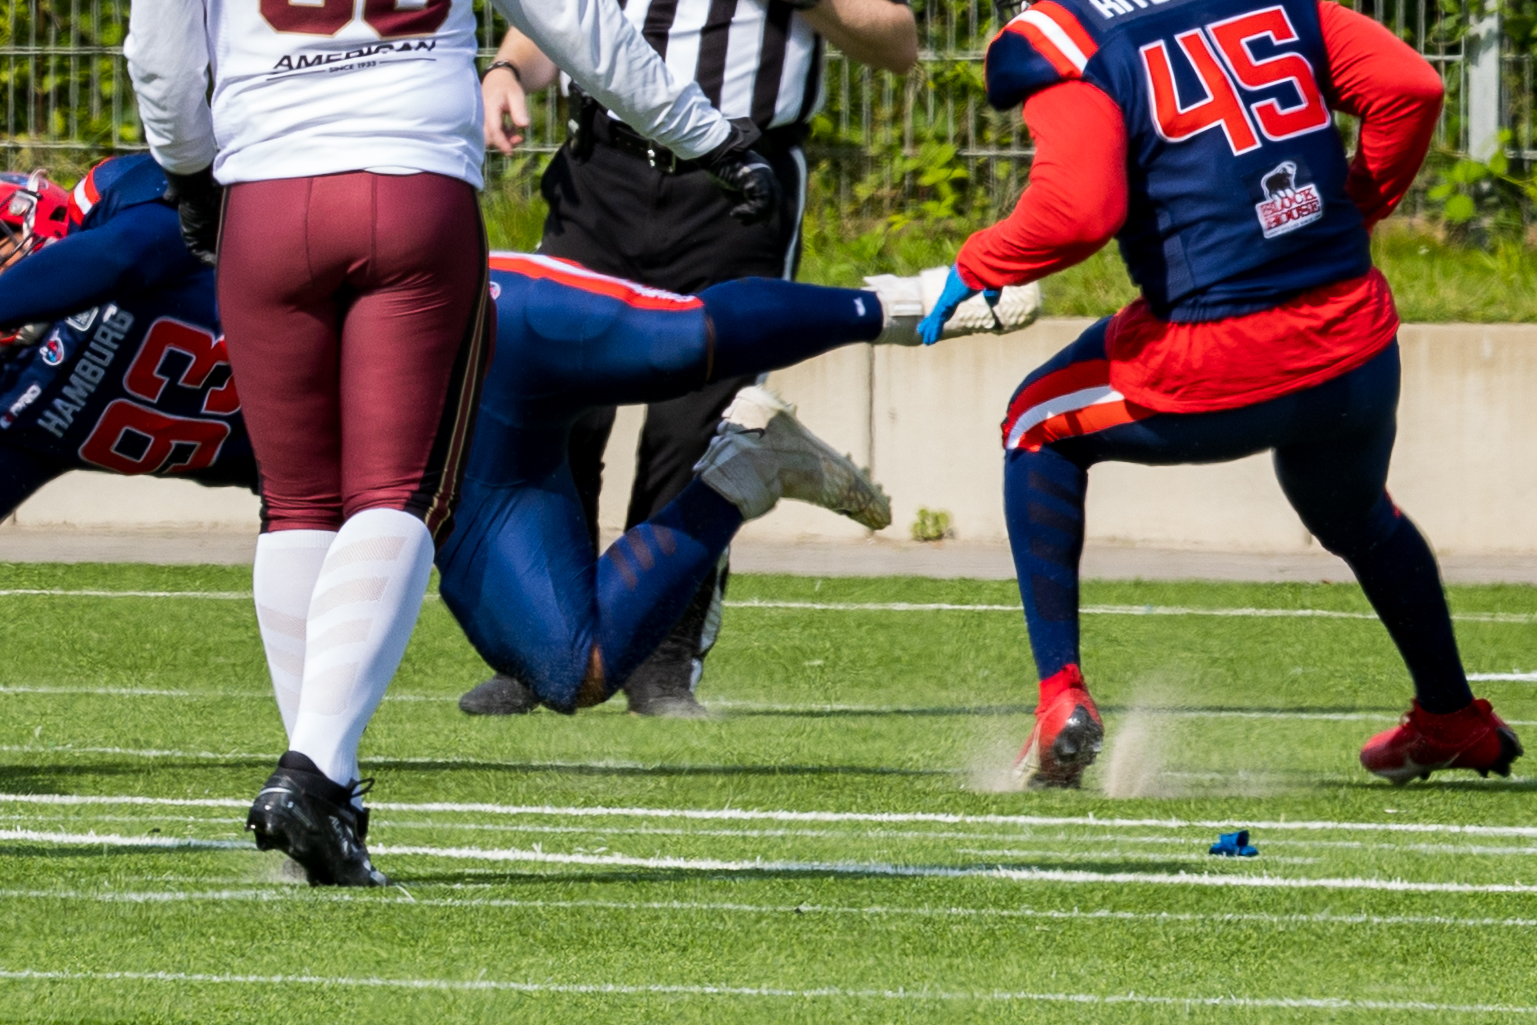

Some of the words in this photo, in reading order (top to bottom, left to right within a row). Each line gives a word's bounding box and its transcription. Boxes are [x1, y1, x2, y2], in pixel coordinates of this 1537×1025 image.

[1139, 4, 1332, 157] 45
[1264, 199, 1321, 231] HOUSE
[36, 303, 135, 438] HAMBURG
[78, 316, 242, 475] 93
